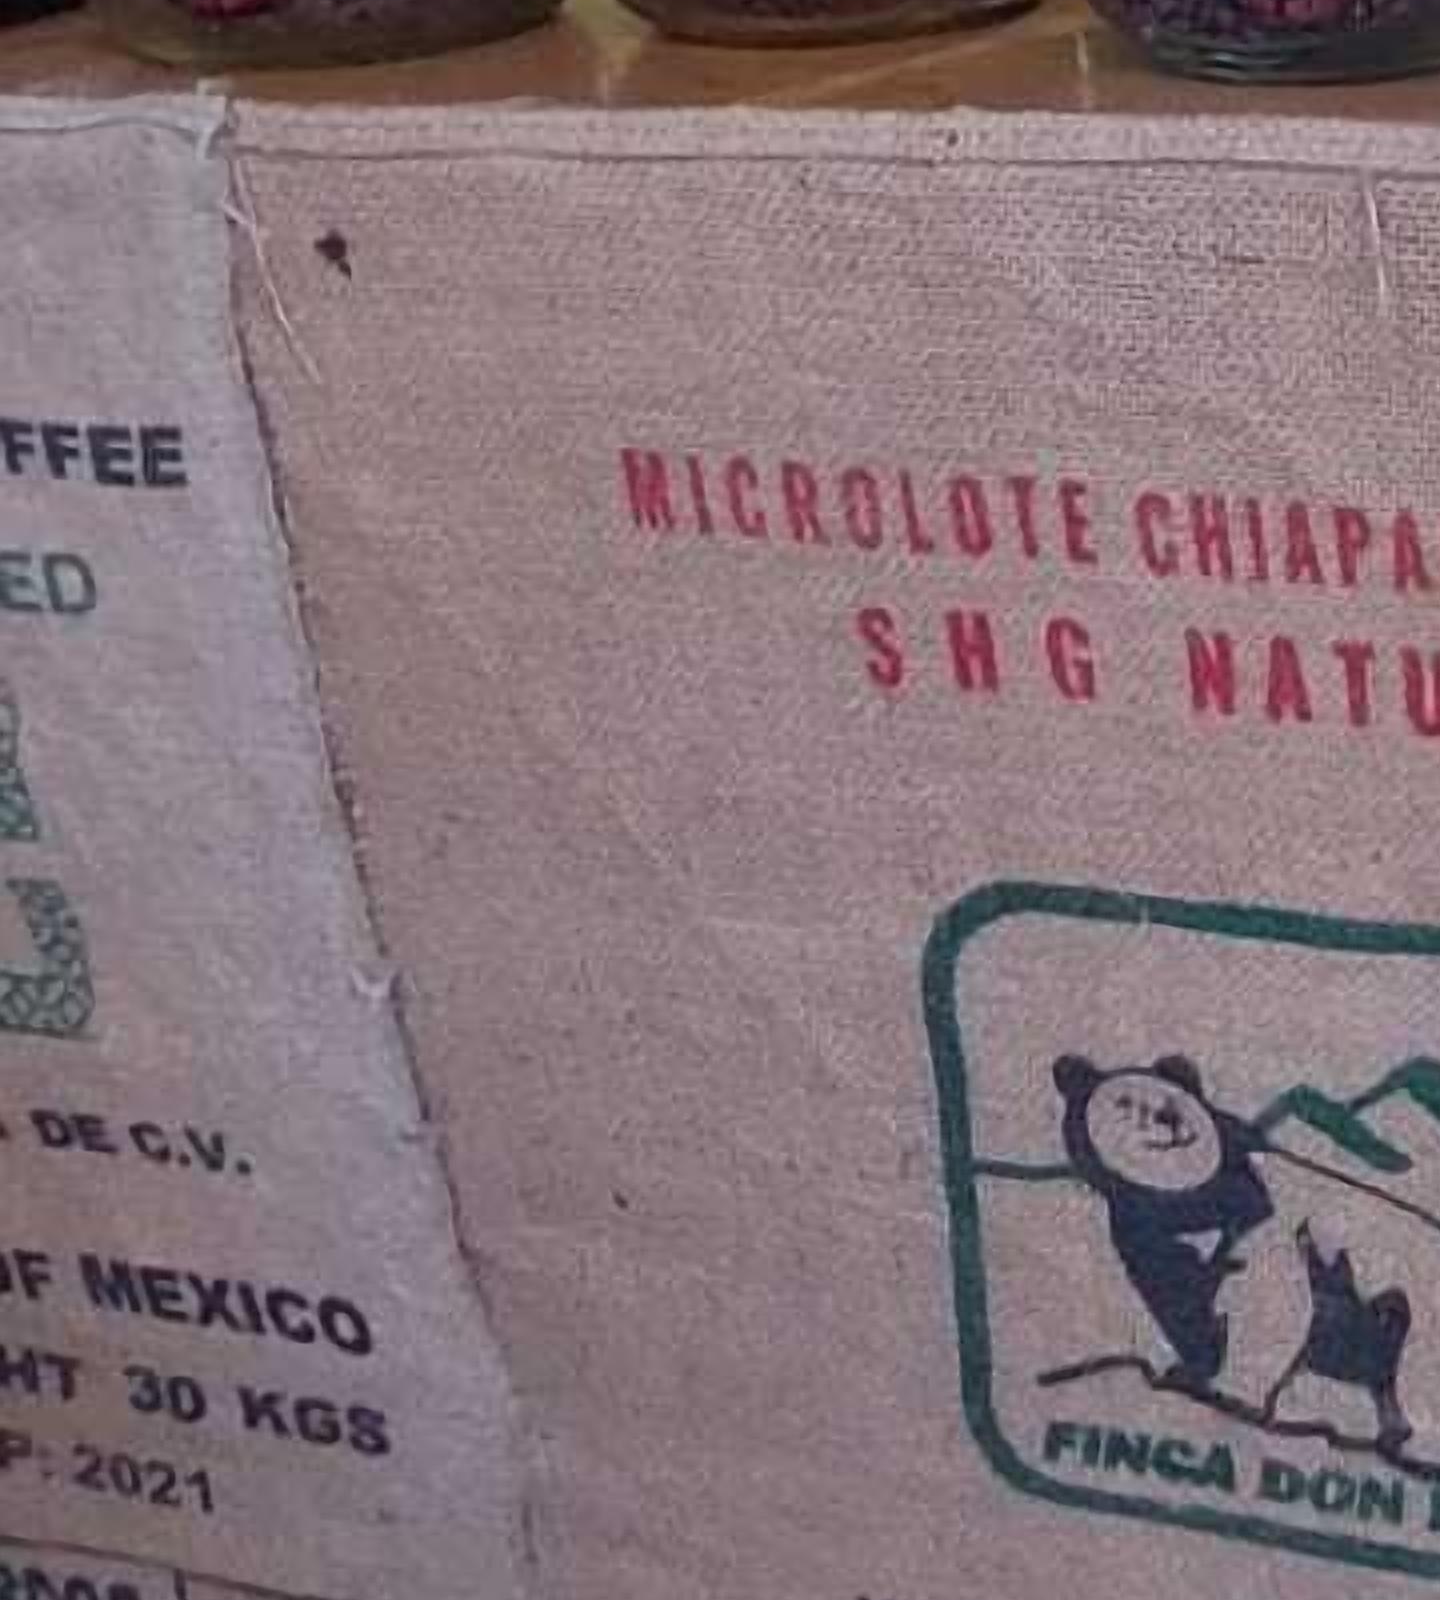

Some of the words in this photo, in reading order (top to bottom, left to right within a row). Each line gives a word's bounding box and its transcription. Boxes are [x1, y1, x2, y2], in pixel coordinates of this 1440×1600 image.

[620, 446, 1099, 565] MICROLOTE
[855, 605, 905, 690] S
[944, 609, 999, 693] H
[1044, 616, 1097, 701] G
[29, 1108, 118, 1154] DE
[128, 1121, 252, 1176] C.V.
[0, 1248, 53, 1300] F
[78, 1252, 373, 1356] MEXICO
[122, 1363, 208, 1424] 30
[237, 1384, 391, 1456] KGS
[72, 1442, 214, 1514] 2021
[1255, 1456, 1403, 1525] DON
